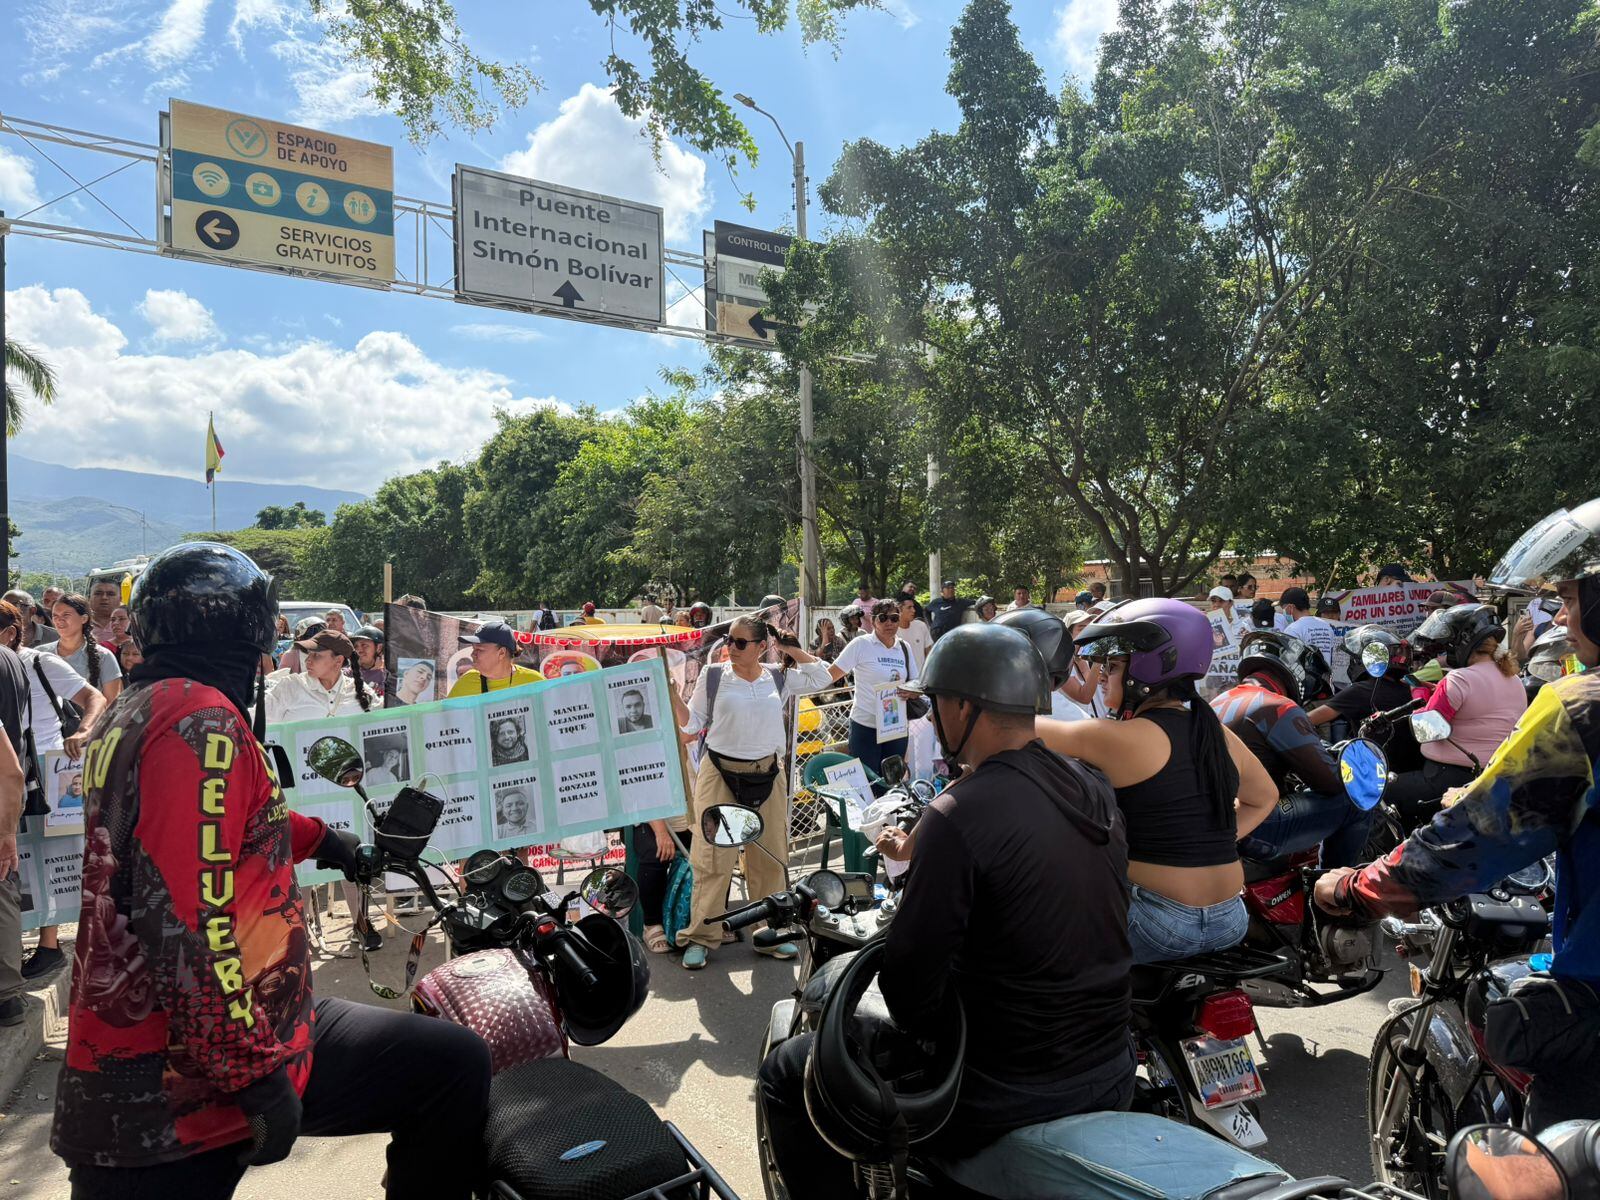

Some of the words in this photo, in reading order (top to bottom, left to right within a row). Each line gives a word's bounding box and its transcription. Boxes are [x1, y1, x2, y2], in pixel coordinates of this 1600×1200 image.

[277, 131, 337, 155] ESPACIO
[277, 148, 299, 163] DE
[300, 153, 348, 173] APOYO
[519, 188, 611, 223] Puente
[279, 226, 372, 253] SERVICIOS
[473, 210, 648, 260] Internacional
[727, 235, 772, 252] CONTROL
[276, 243, 377, 271] GRATUITOS
[472, 239, 559, 272] Simón
[568, 257, 654, 290] Bolívar
[1351, 590, 1405, 607] FAMILIARES
[1408, 588, 1446, 601] UNID
[1345, 609, 1367, 621] POR
[1370, 606, 1385, 619] UN
[1388, 603, 1415, 616] SOLO
[608, 676, 650, 689] LIBERTAD
[488, 706, 530, 720] LIBERTAD
[553, 704, 590, 715] MANUEL
[548, 712, 595, 726] ALEJANDRO
[362, 725, 407, 737] LIBERTAD
[440, 727, 460, 737] LUIS
[559, 723, 587, 735] TIQUE
[425, 737, 472, 750] QUINCHIA
[618, 761, 666, 776] HUMBERTO
[492, 775, 537, 790] LIBERTAD
[561, 770, 596, 783] DANNER
[620, 772, 665, 786] RAMIREZ
[558, 780, 598, 793] GONZALO
[560, 790, 599, 804] BARAJAS
[441, 815, 473, 826] ASTAÑO
[44, 853, 83, 865] PANTALEON
[55, 866, 66, 874] DE
[67, 864, 75, 872] LA
[49, 874, 82, 885] ASUNCION
[53, 885, 80, 895] ARAGON
[1271, 888, 1292, 906] OWEN
